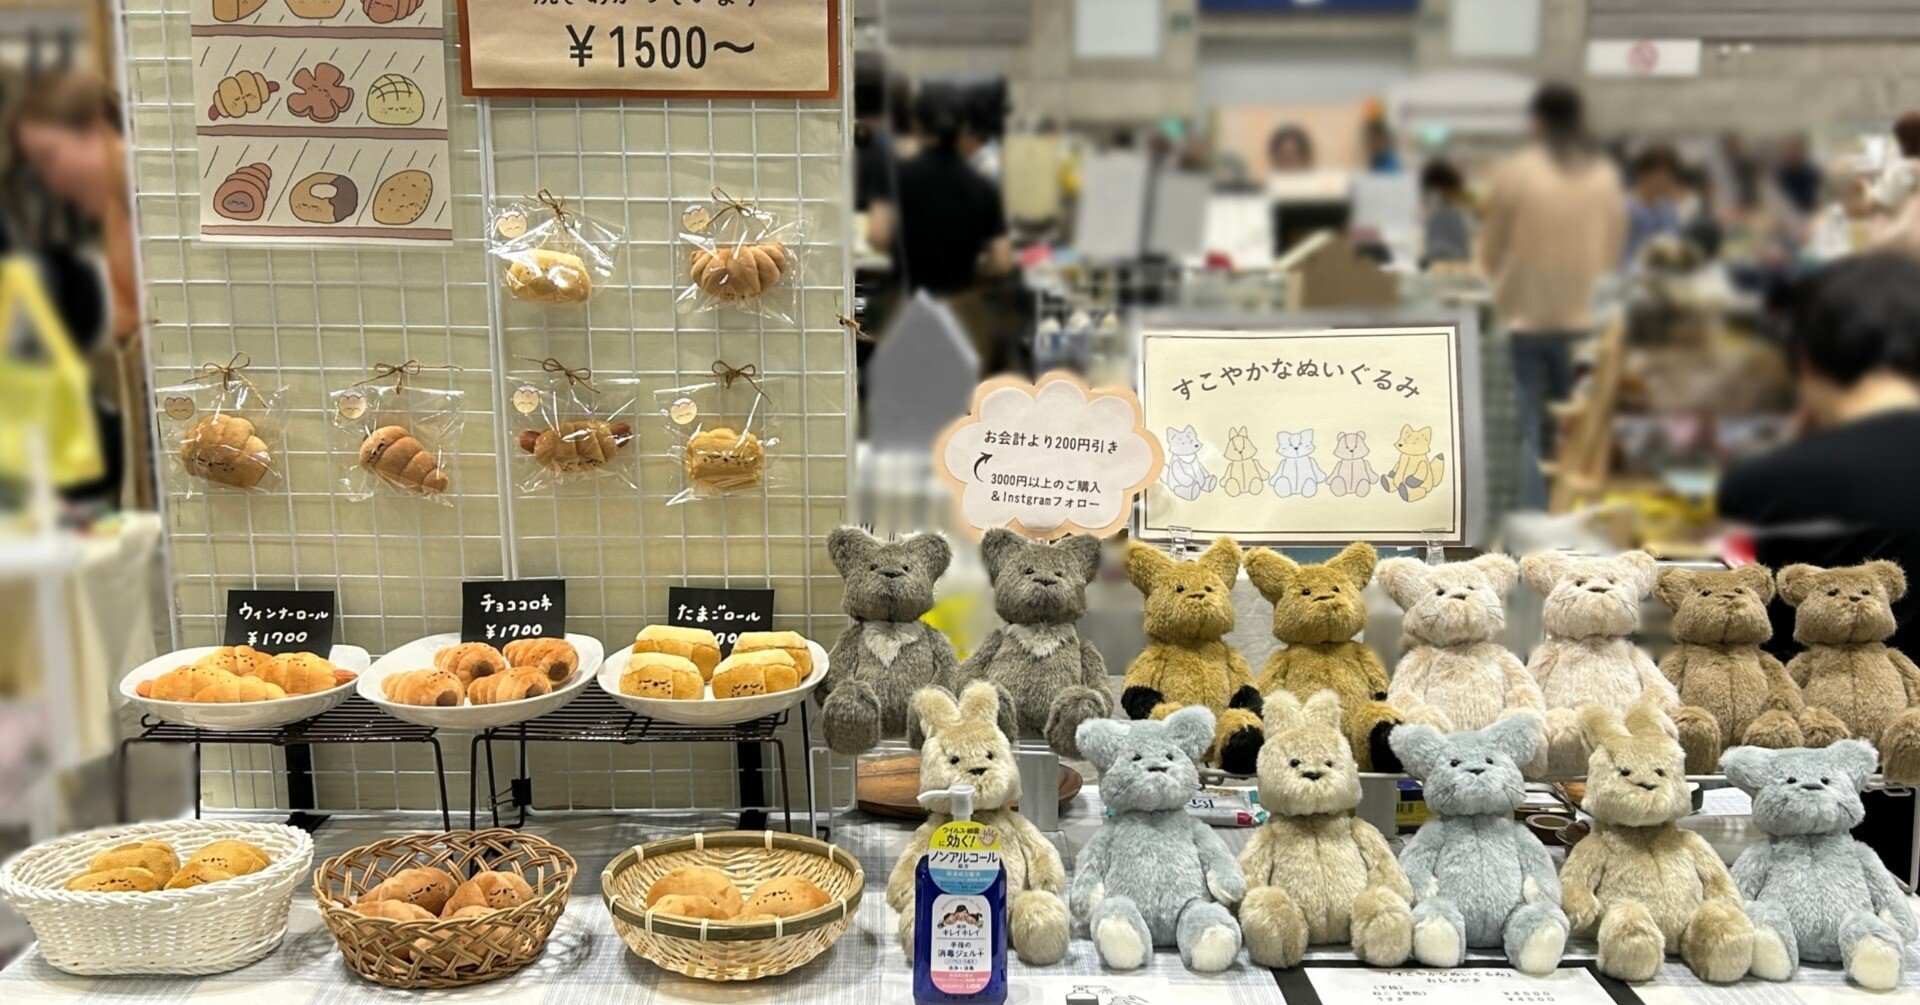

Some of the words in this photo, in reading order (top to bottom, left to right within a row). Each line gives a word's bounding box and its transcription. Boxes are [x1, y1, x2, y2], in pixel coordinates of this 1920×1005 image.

[1171, 356, 1422, 401] すこやかなぬいぐるみ
[984, 430, 1119, 455] お会計より200円引き
[990, 473, 1102, 494] 3000円以上のご購入
[238, 601, 330, 620] ウィンナーロール
[480, 593, 553, 613] チョココロネ
[676, 603, 761, 623] たまごロール
[247, 630, 308, 647] ¥1700
[485, 623, 543, 640] ¥1700
[930, 850, 998, 864] ノンアルコール
[942, 929, 980, 937] キレイキレイ
